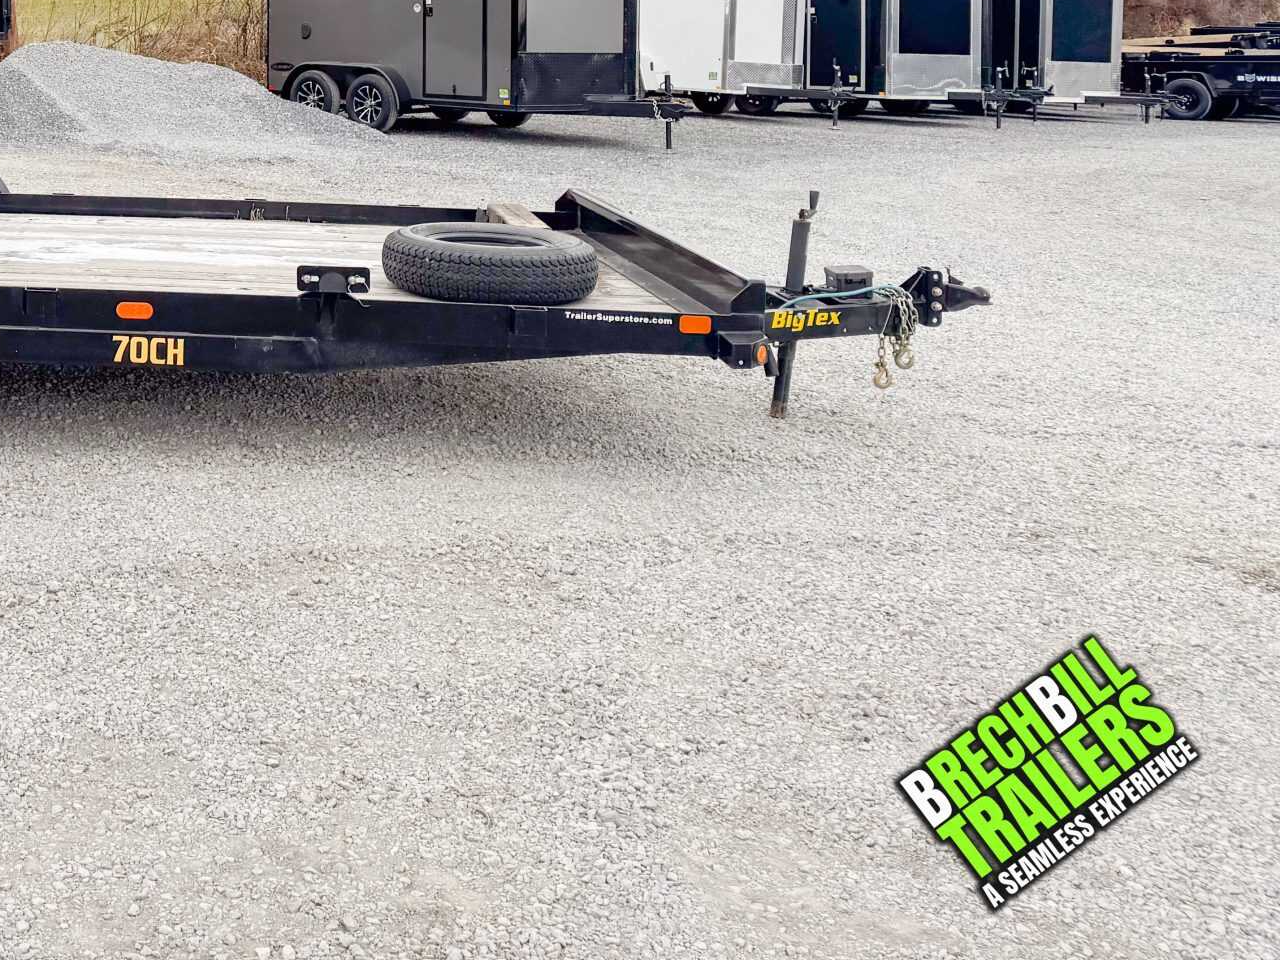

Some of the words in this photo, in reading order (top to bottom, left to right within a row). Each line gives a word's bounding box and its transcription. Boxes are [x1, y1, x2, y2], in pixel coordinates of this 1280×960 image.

[564, 311, 673, 325] TrailerSuperstore.com
[771, 309, 842, 332] BigTex
[112, 335, 185, 366] 70CH
